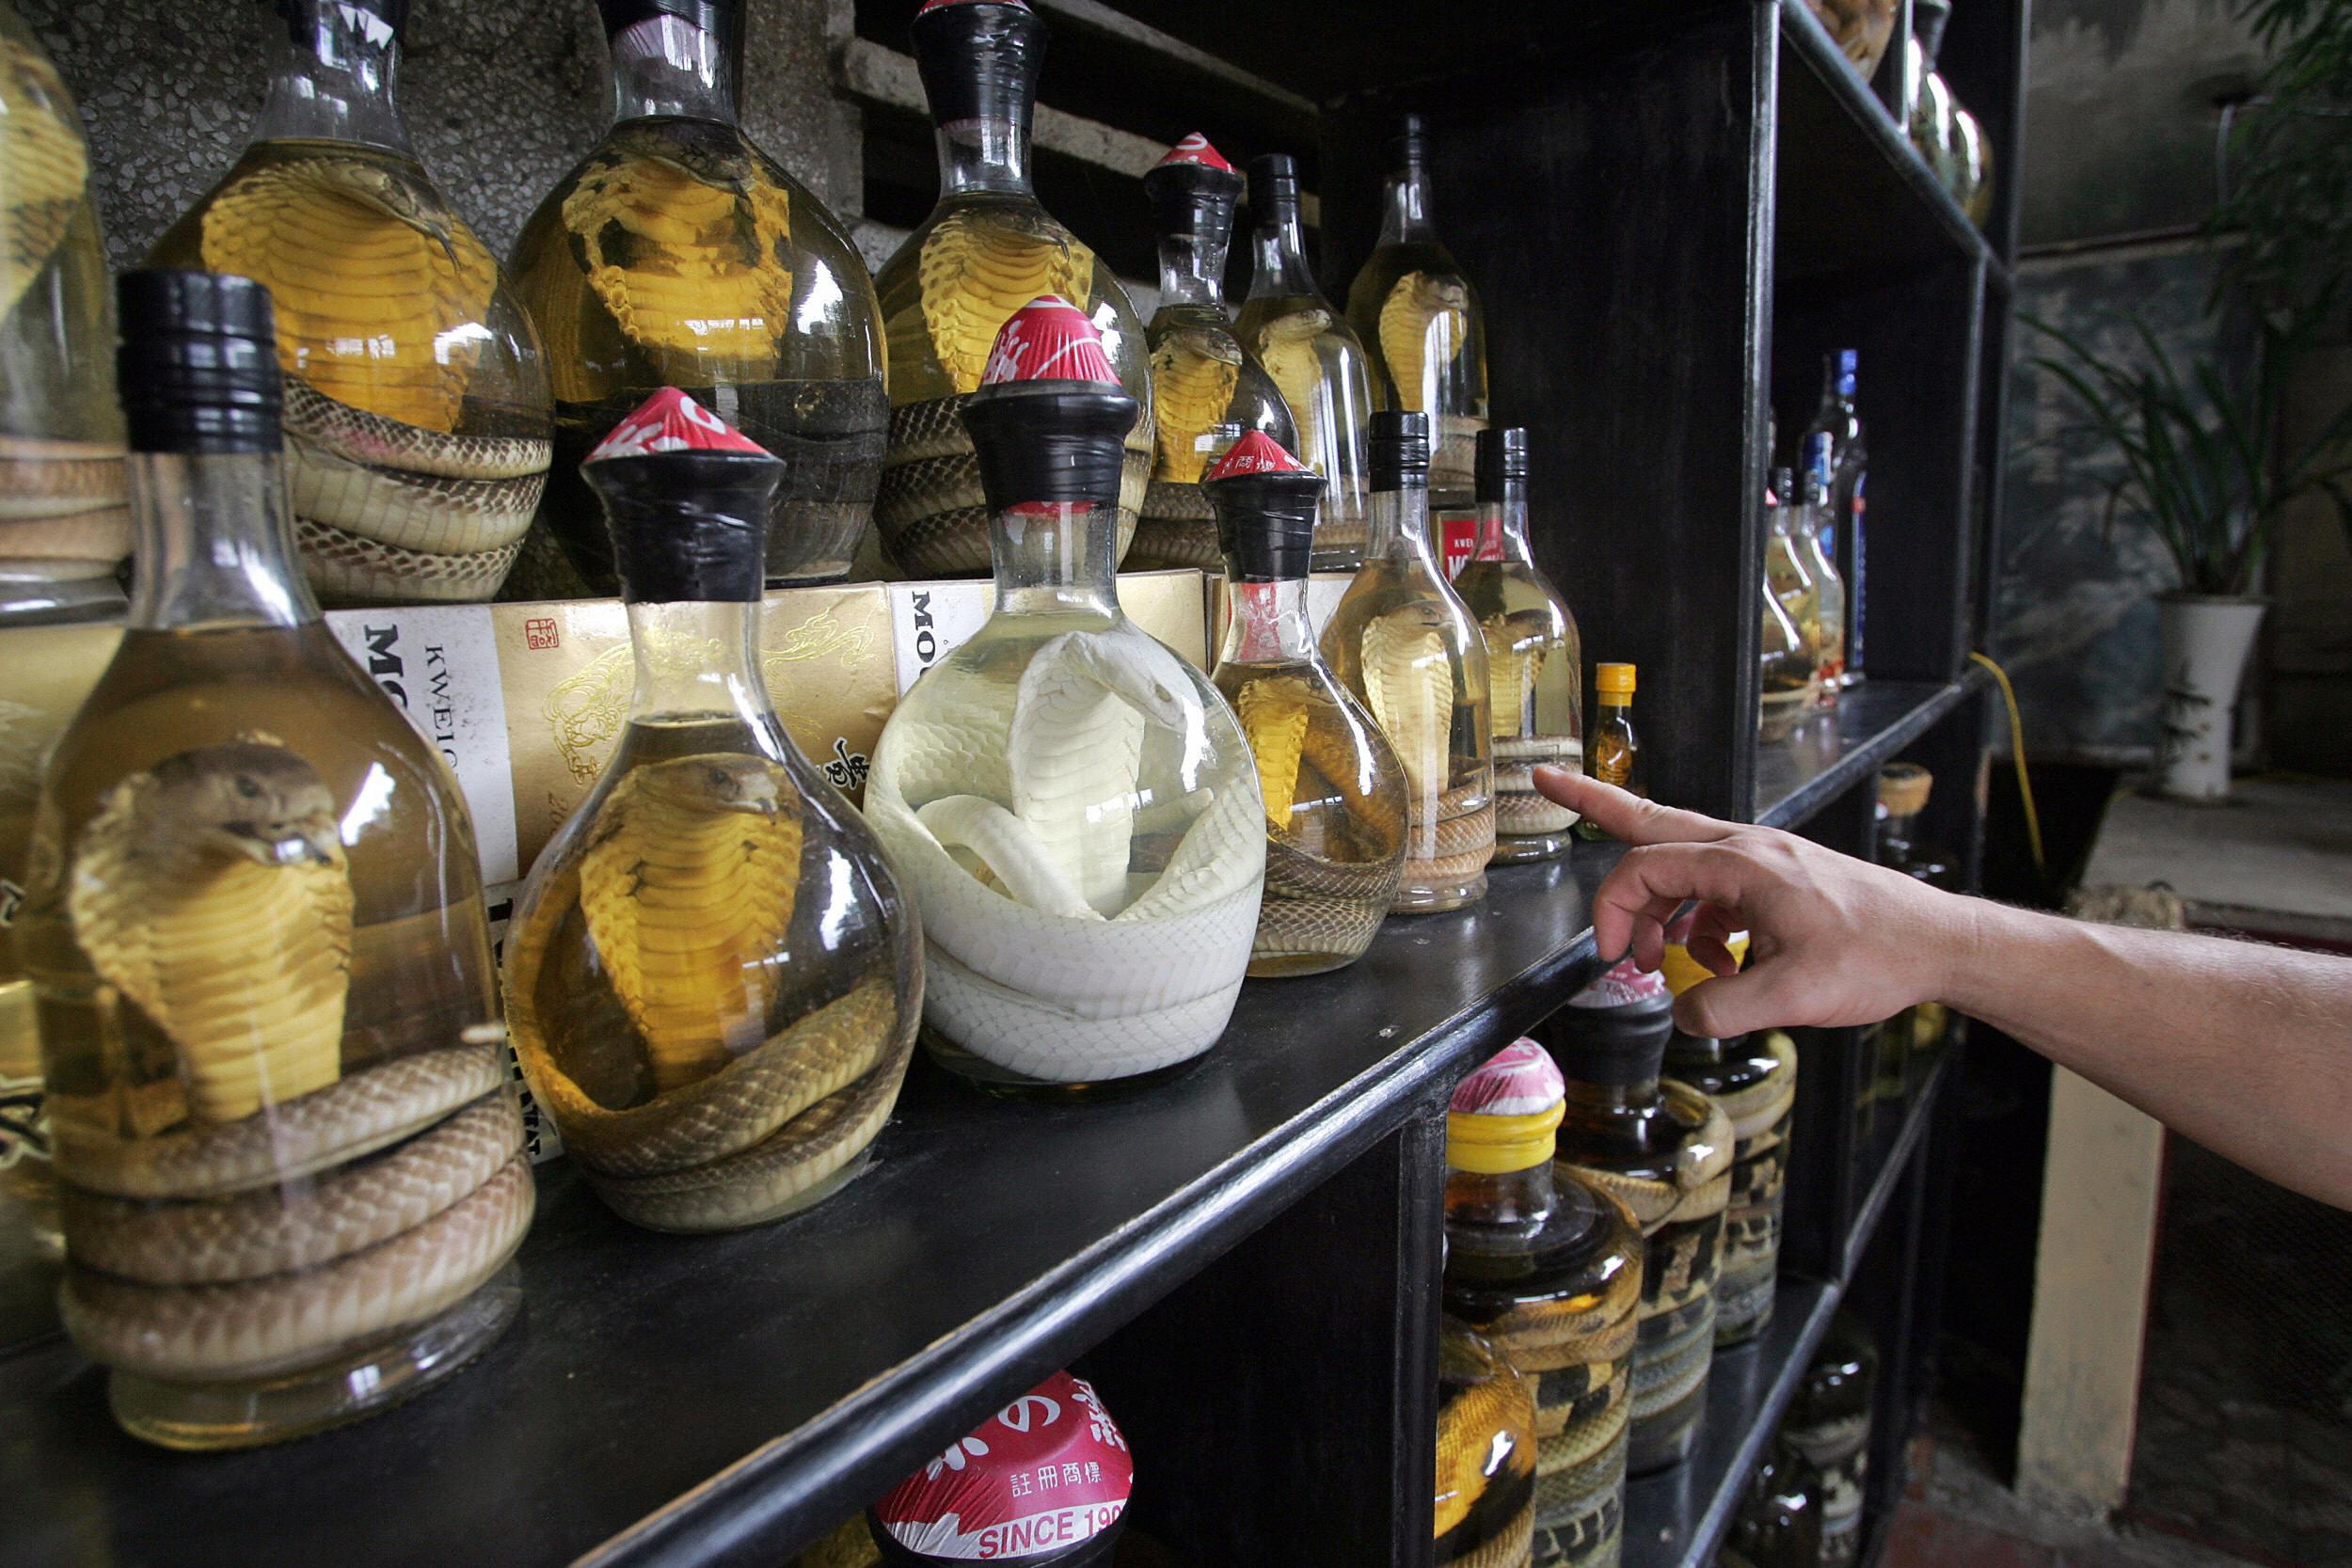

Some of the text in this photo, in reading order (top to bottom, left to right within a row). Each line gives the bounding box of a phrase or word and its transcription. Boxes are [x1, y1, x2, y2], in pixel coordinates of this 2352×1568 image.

[912, 591, 937, 676] MO
[1010, 1461, 1102, 1498] 註冊商標
[978, 1511, 1074, 1559] SINCE
